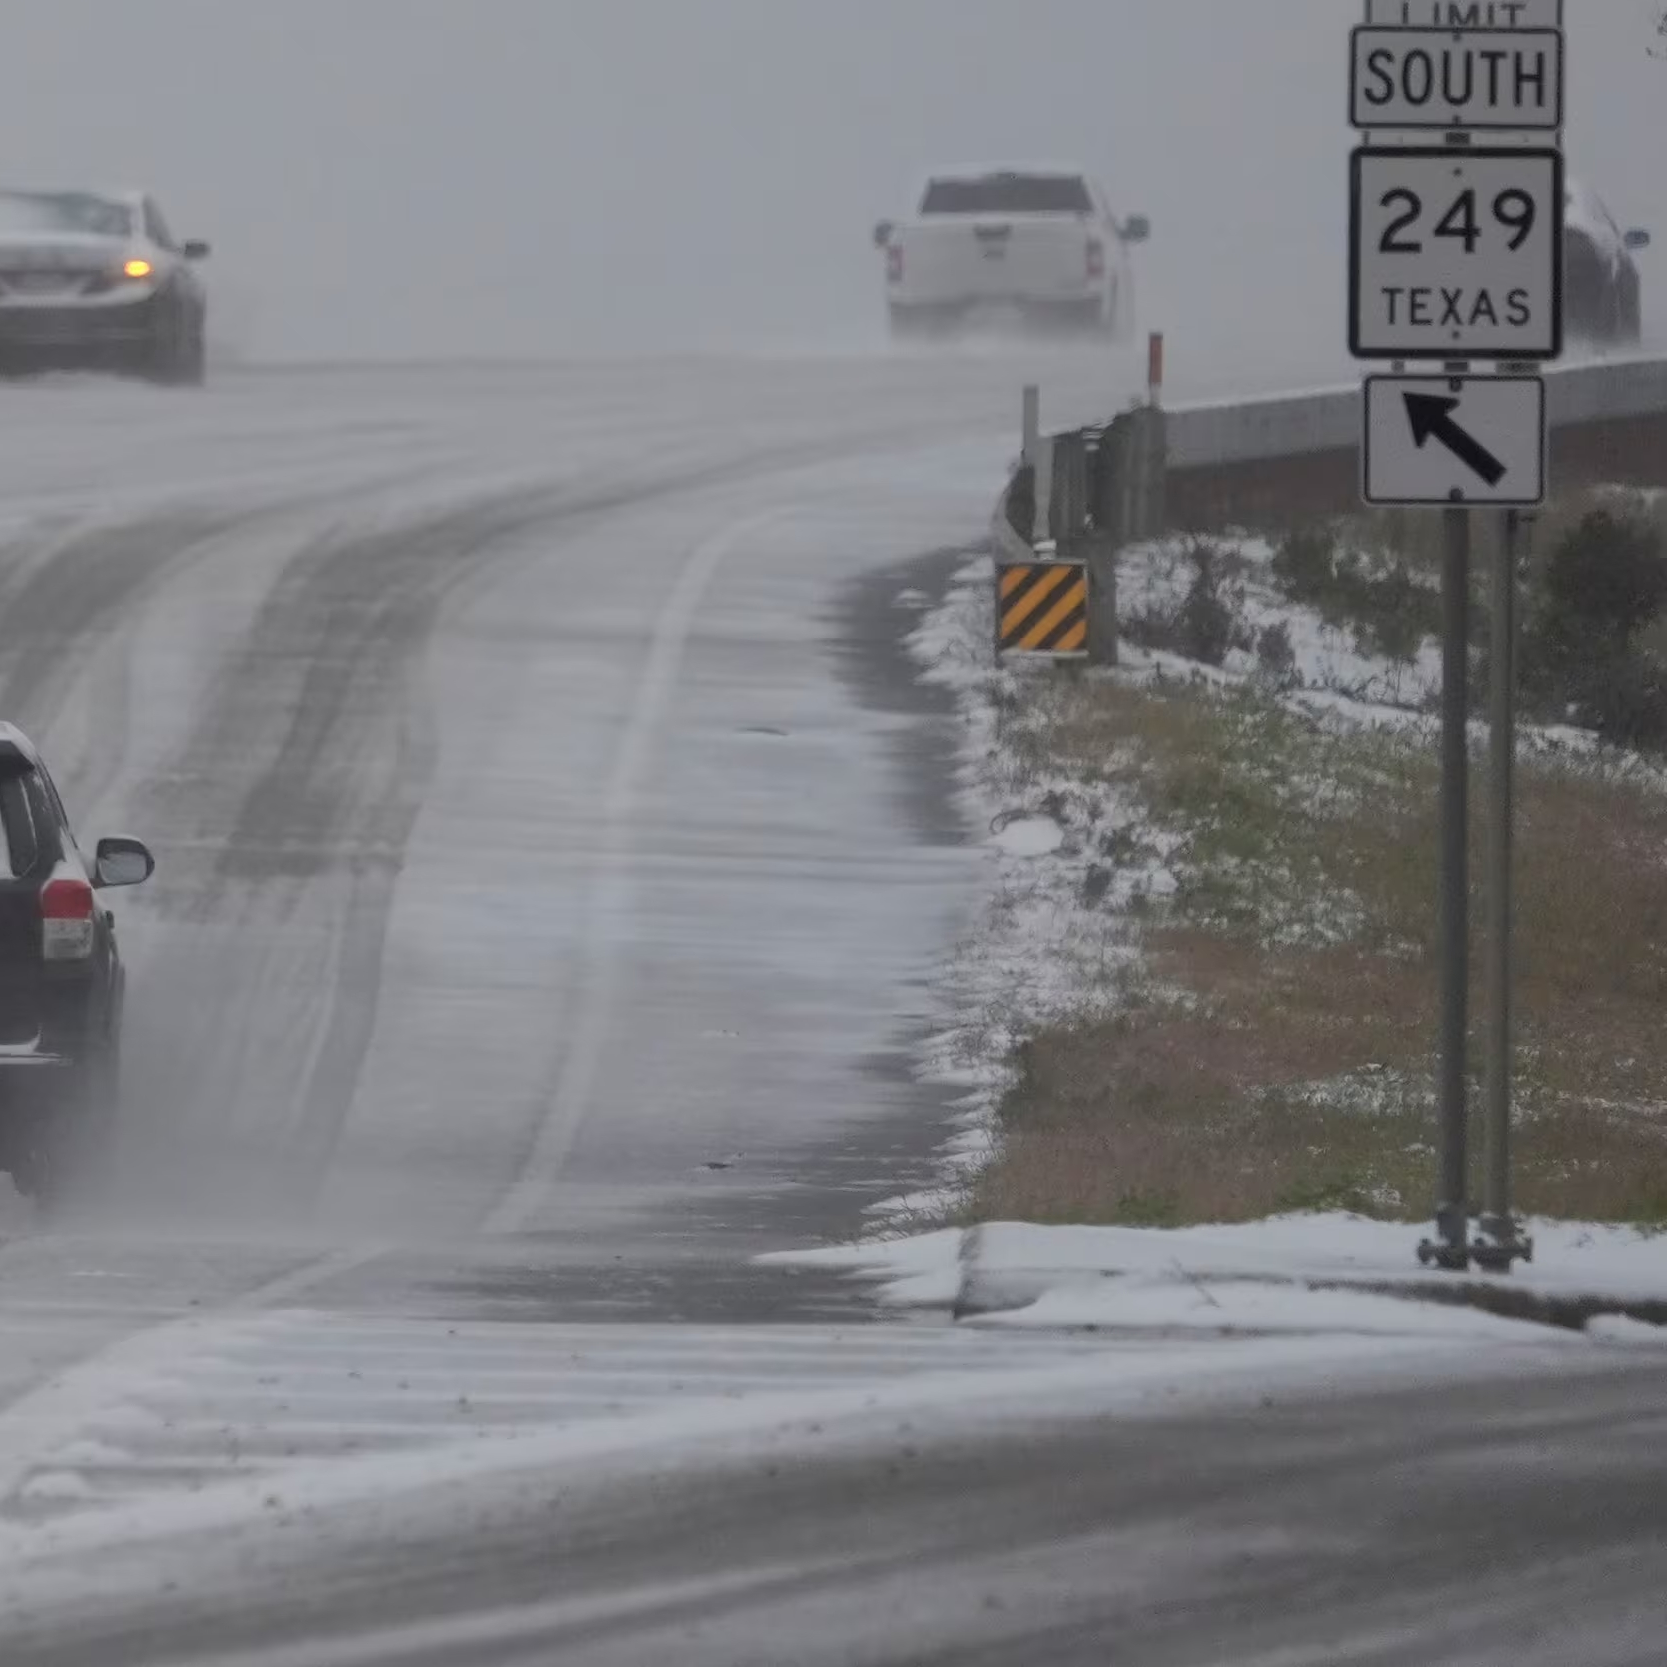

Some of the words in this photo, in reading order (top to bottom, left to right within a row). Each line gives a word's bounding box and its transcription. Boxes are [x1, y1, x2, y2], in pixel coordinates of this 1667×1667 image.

[1363, 47, 1547, 108] SOUTH
[1377, 186, 1536, 256] 249
[1381, 287, 1531, 327] TEXAS
